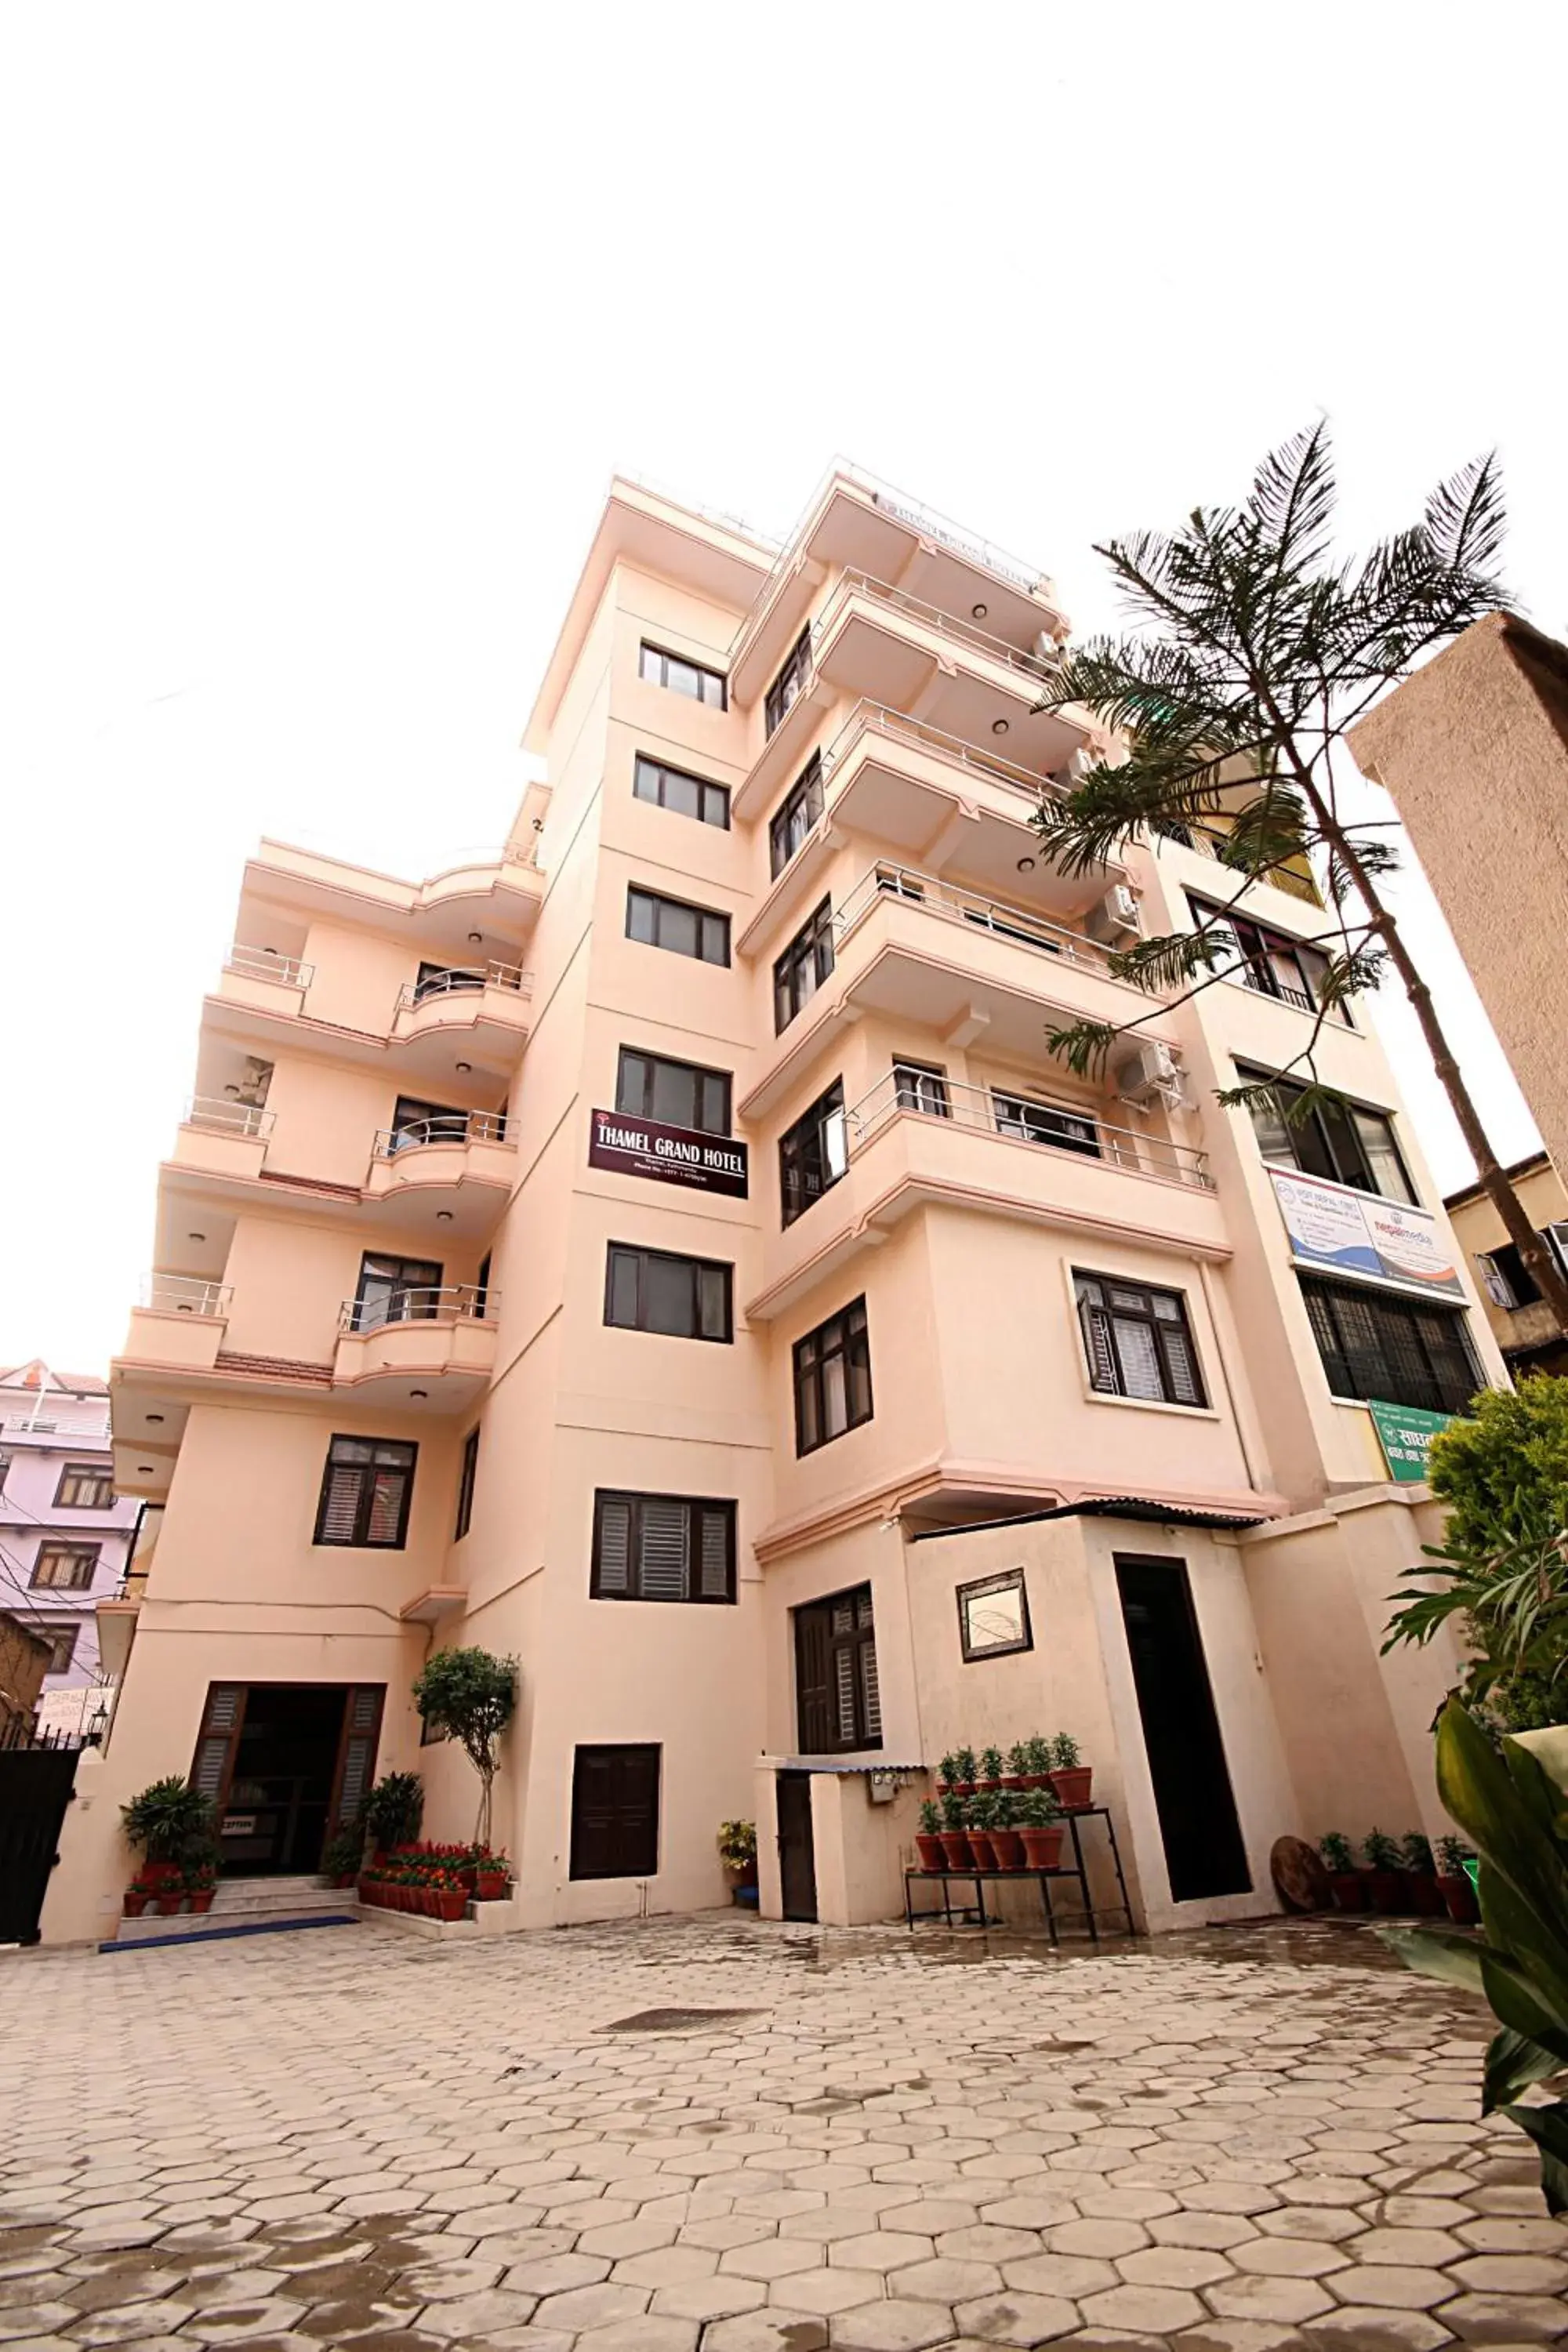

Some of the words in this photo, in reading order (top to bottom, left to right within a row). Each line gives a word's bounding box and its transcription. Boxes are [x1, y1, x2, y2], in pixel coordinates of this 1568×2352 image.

[597, 1125, 651, 1152] THAMEL
[655, 1138, 700, 1163] GRAND
[704, 1149, 746, 1173] HOTEL
